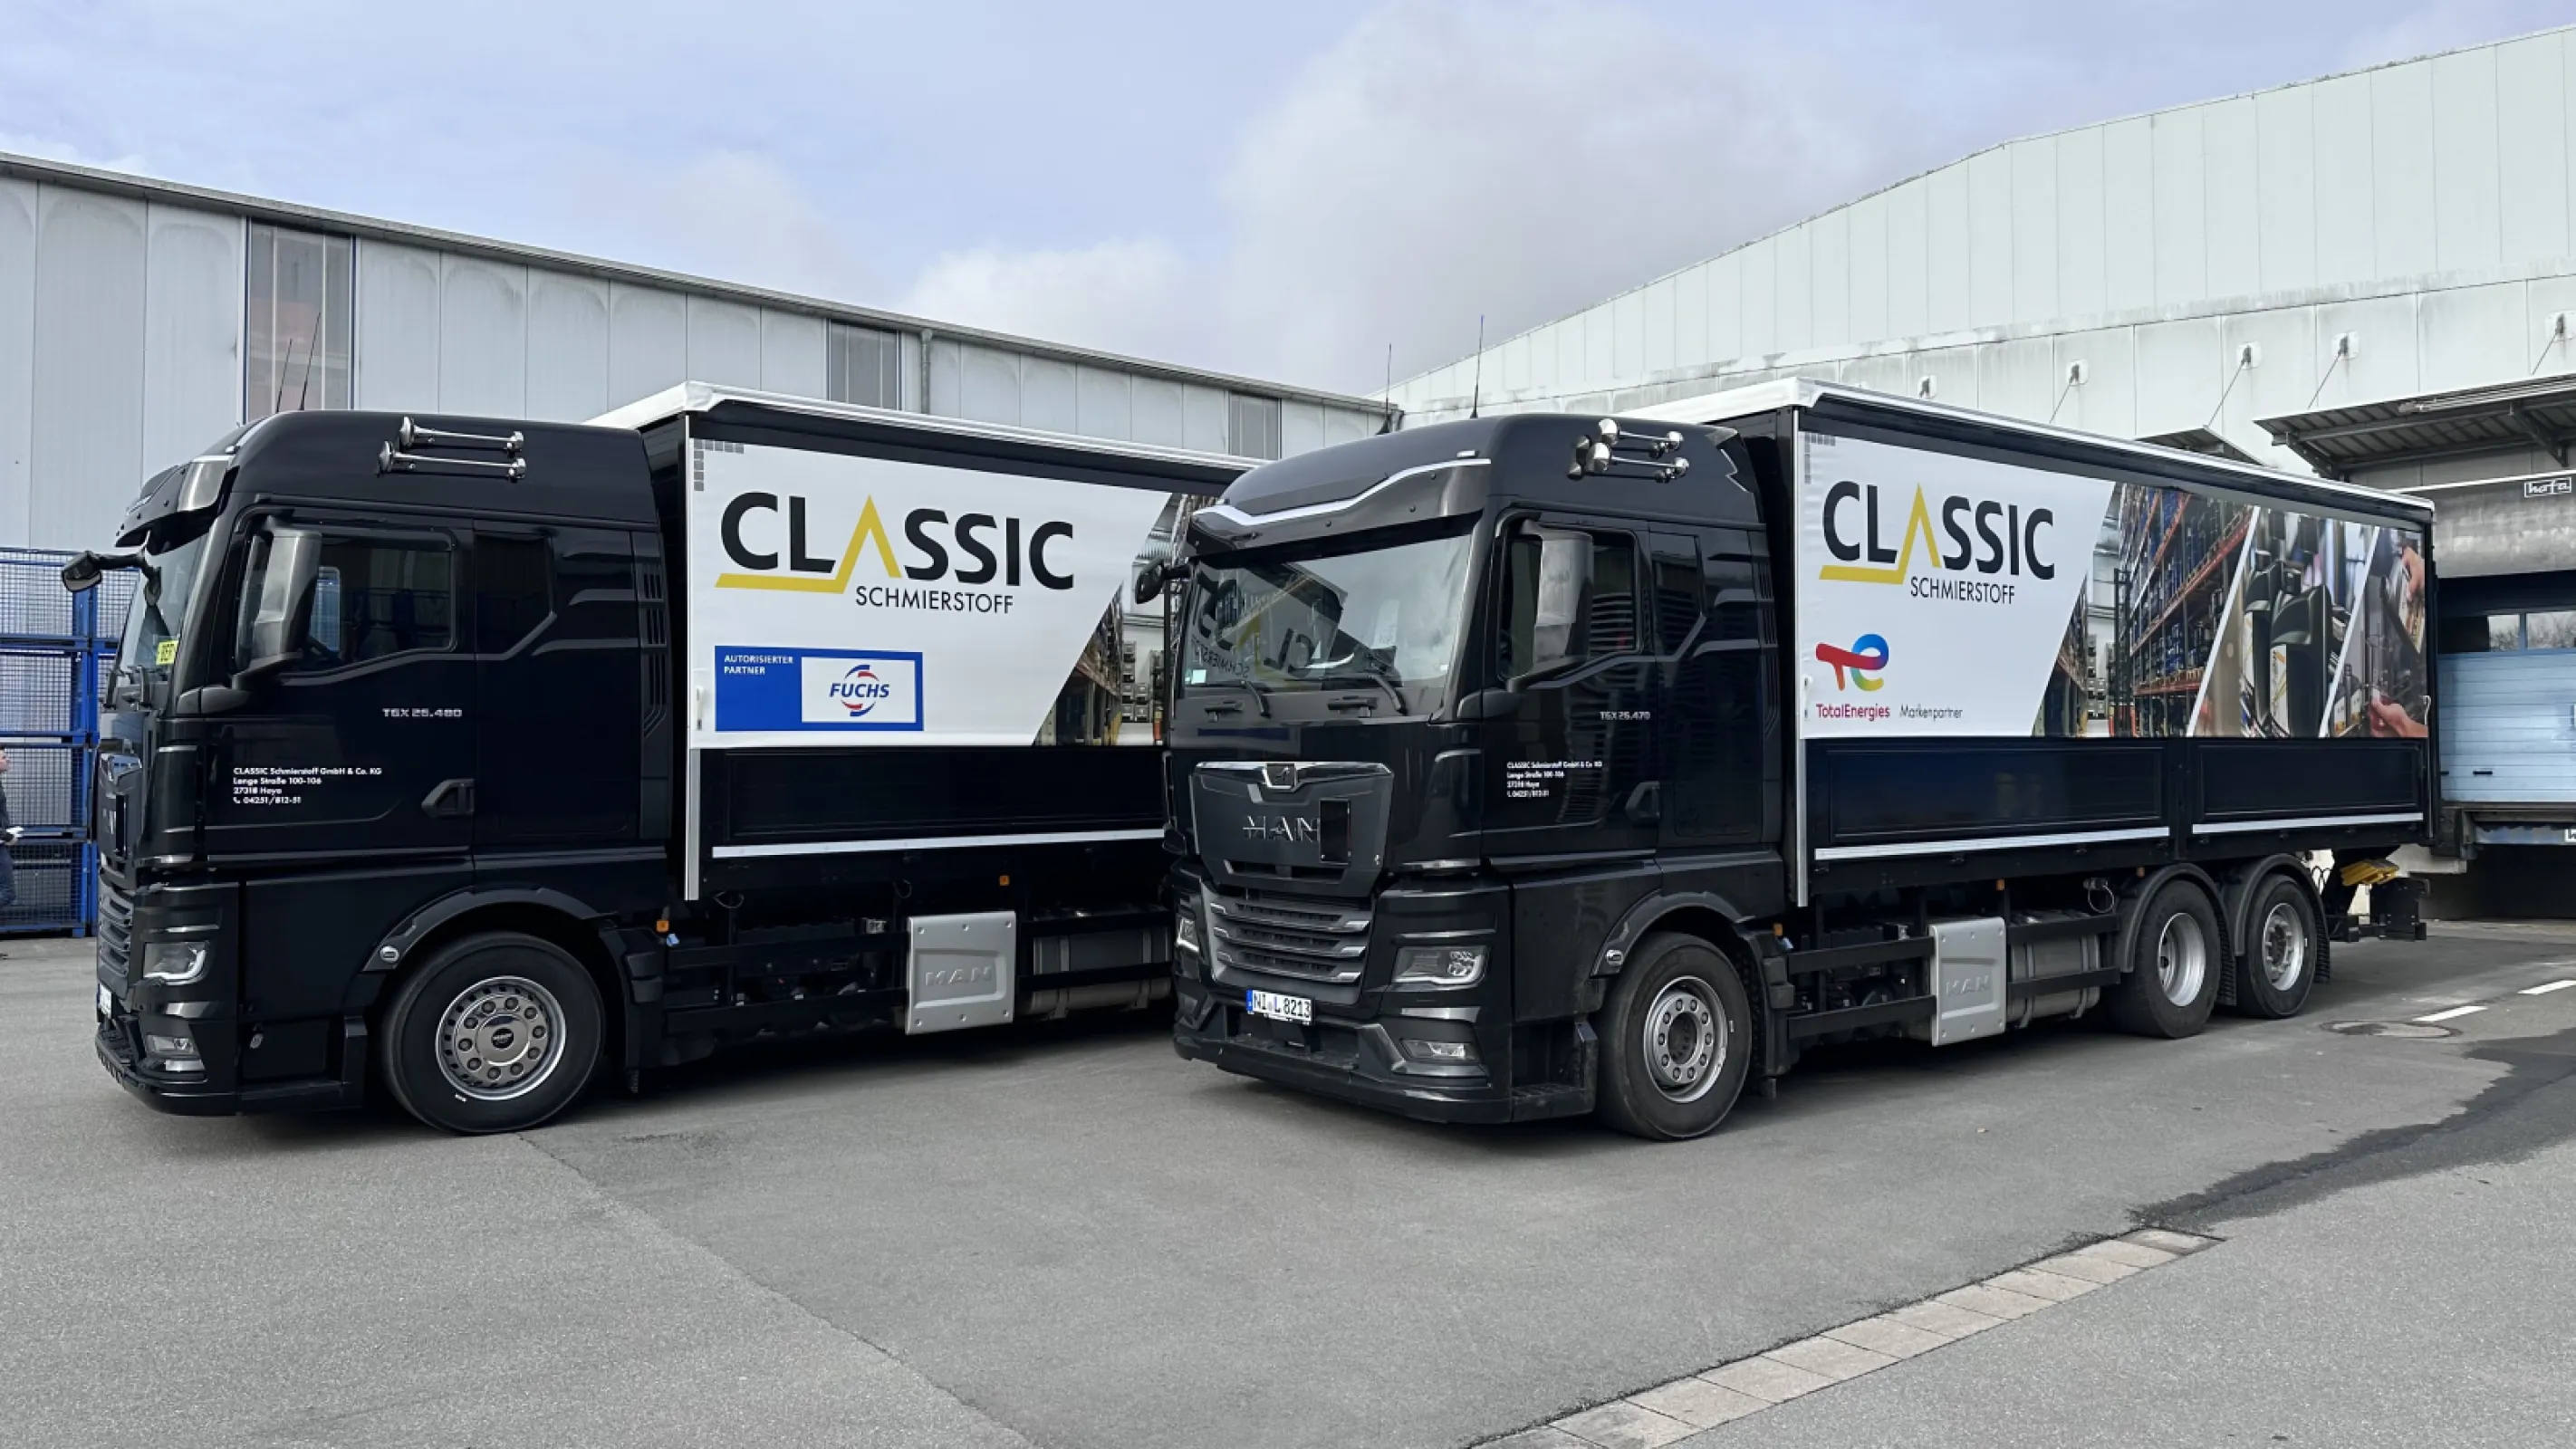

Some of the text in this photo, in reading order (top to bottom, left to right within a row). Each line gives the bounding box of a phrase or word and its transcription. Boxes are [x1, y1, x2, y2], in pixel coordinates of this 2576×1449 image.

[1819, 480, 2055, 584] CLASSIC
[715, 492, 1073, 594] CLASSIC
[855, 585, 1014, 615] SCHMIERSTOFF
[1909, 576, 2016, 605] SCHMIERSTOFF
[724, 655, 794, 665] AUTORISIERTER
[724, 666, 766, 676] PARTNER
[829, 683, 890, 699] FUCHS
[382, 707, 409, 717] TGX
[1600, 711, 1618, 721] TGX
[1816, 703, 1890, 722] TotalEnergies
[1899, 703, 1964, 722] Markenpartner
[233, 767, 268, 775] CLASSIC
[270, 766, 319, 775] Schmierstoff
[320, 767, 345, 775] GmbH
[370, 767, 382, 775] KG
[233, 777, 258, 786] Lange
[925, 965, 993, 987] MAN
[1946, 974, 1990, 997] MAN
[1283, 998, 1310, 1019] 8213
